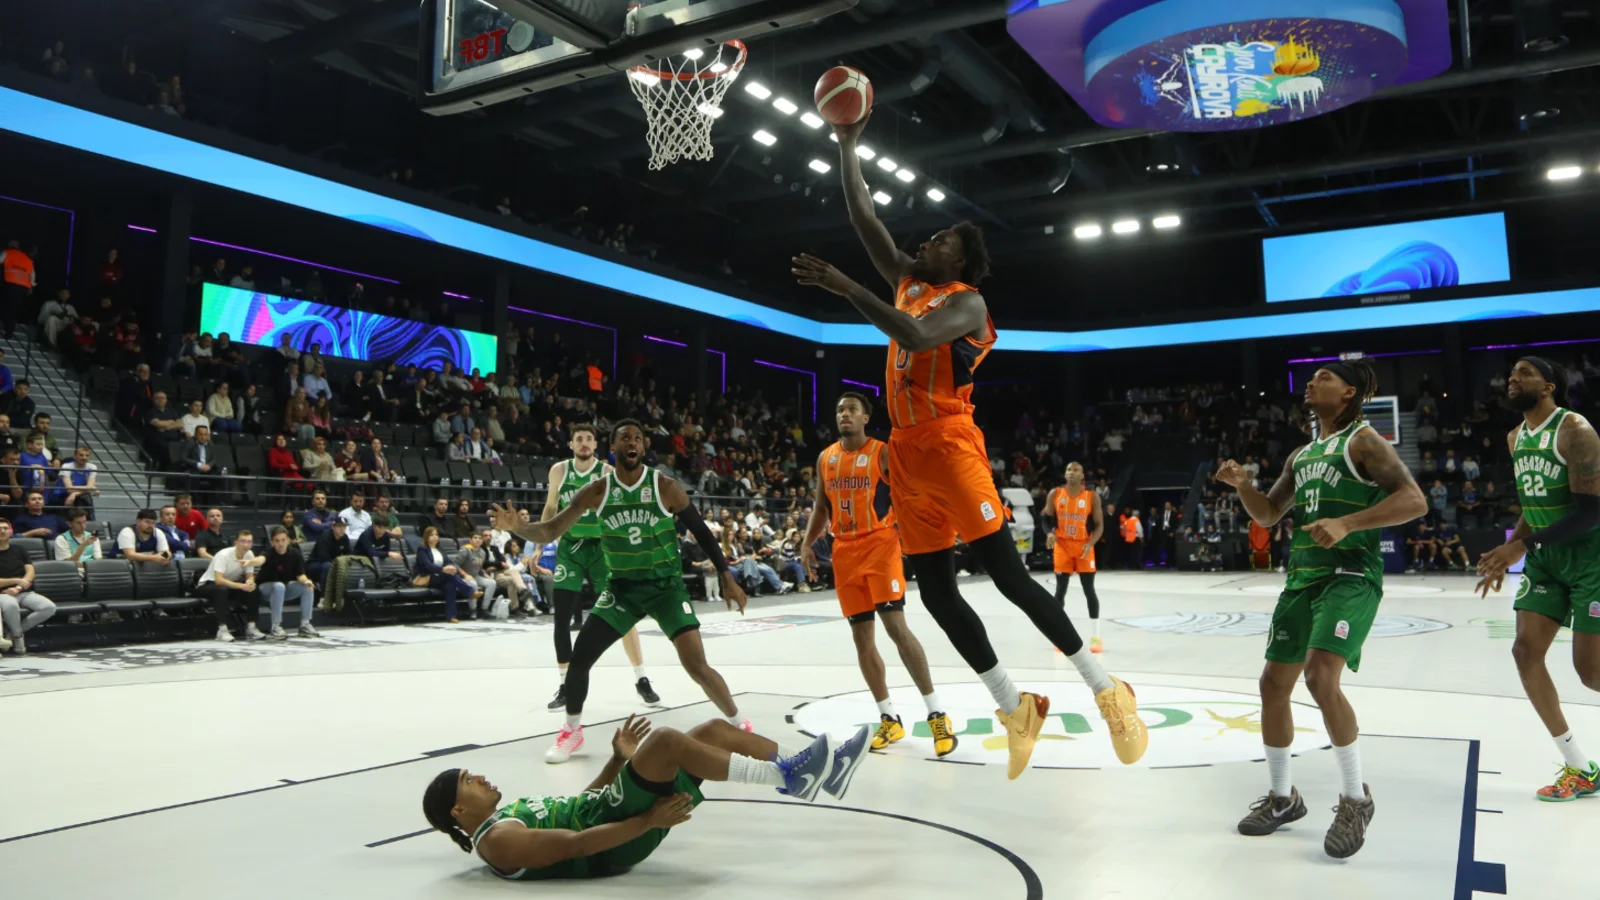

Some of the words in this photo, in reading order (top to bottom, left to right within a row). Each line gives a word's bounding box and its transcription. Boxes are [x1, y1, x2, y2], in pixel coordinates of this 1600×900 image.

[1225, 41, 1276, 73] Spor
[1295, 462, 1343, 493] URSASPOR
[1522, 474, 1547, 497] 22
[841, 499, 852, 517] 4
[1305, 488, 1320, 513] 31
[628, 526, 642, 545] 2
